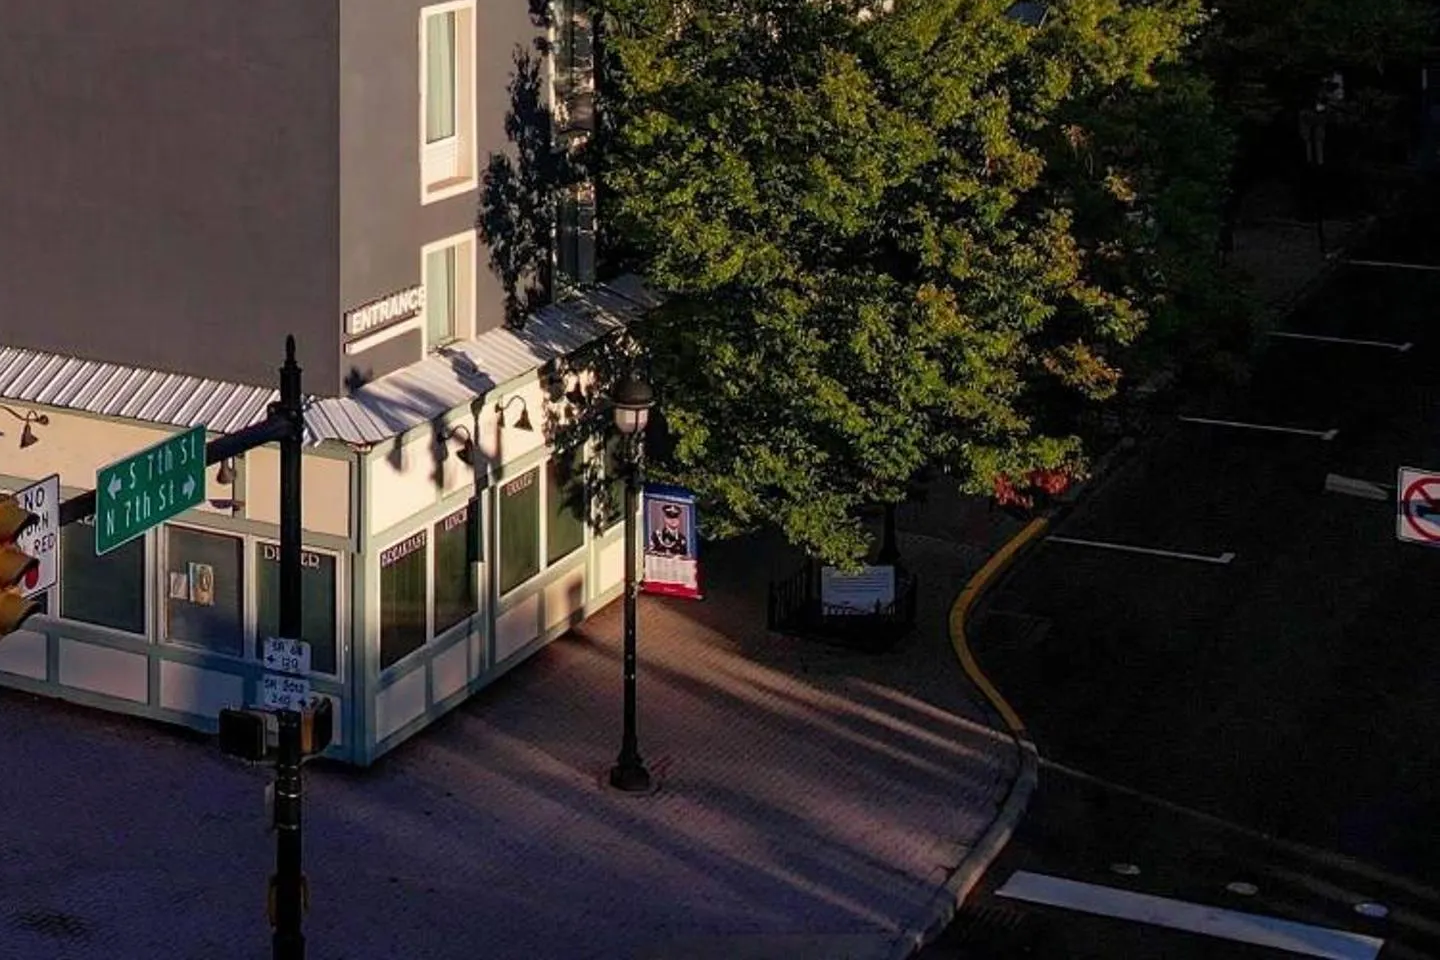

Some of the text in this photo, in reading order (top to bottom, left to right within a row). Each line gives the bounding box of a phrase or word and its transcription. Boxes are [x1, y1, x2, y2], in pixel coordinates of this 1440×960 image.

[352, 286, 424, 335] ENTRANCE
[129, 431, 196, 490] S 7th St
[24, 487, 45, 511] NO
[106, 507, 116, 537] N
[124, 490, 151, 529] 7th
[159, 478, 175, 512] St
[34, 532, 54, 553] RED
[263, 544, 320, 568] DIER
